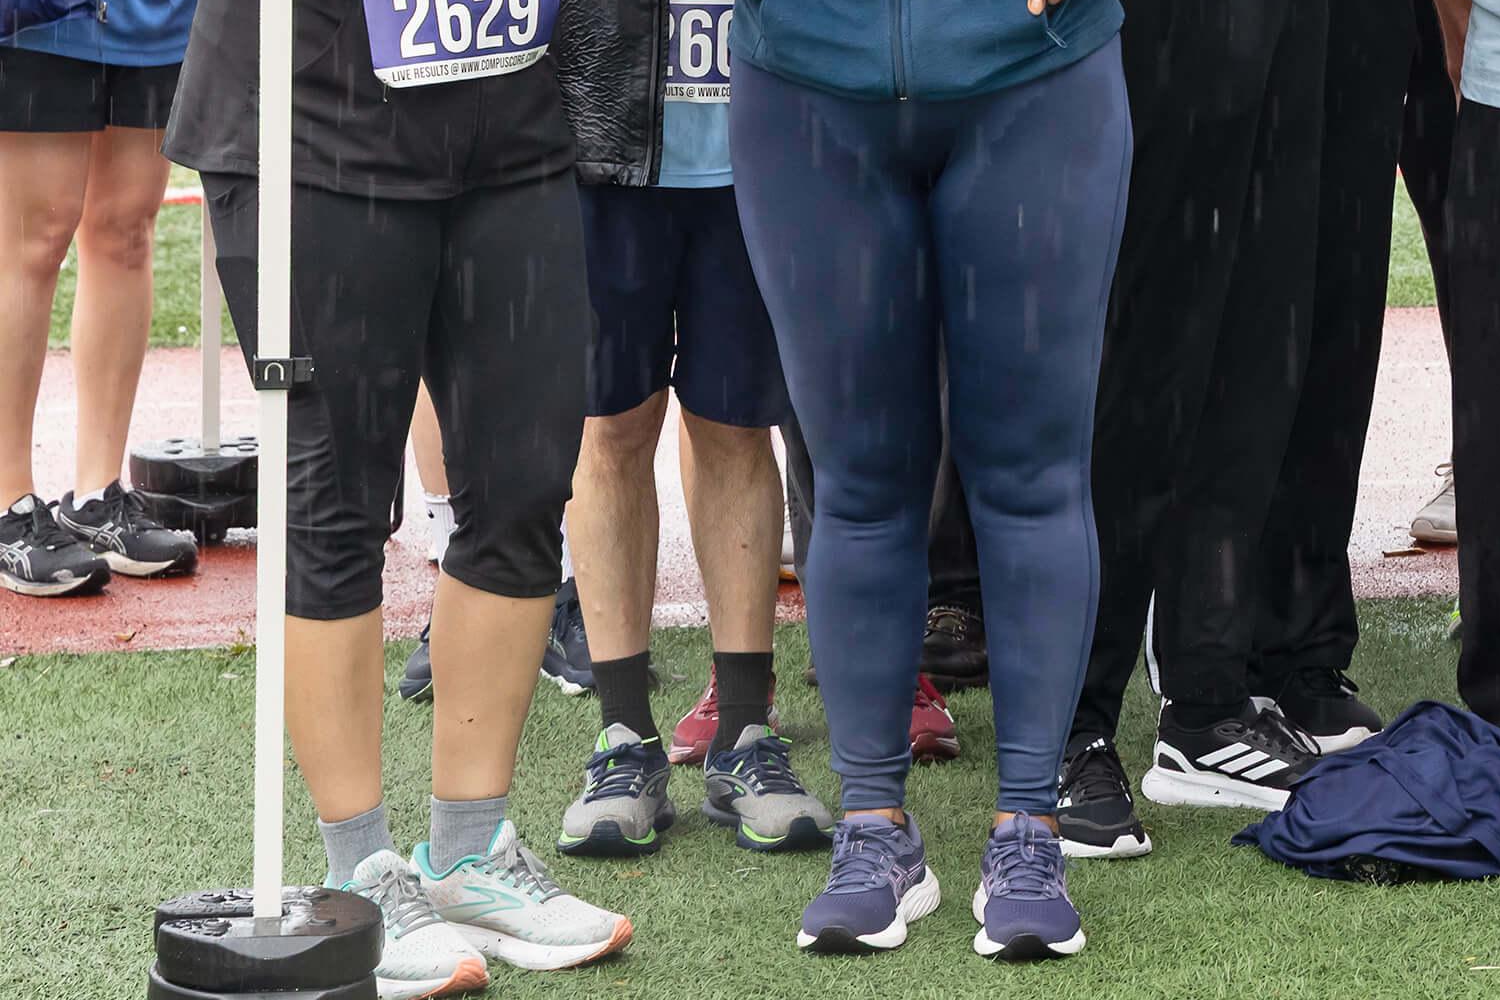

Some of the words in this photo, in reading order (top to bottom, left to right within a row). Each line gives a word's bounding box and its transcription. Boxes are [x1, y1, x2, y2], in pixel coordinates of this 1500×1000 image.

[391, 68, 412, 82] LIVE
[414, 64, 449, 80] RESULTS
[450, 64, 460, 76] @
